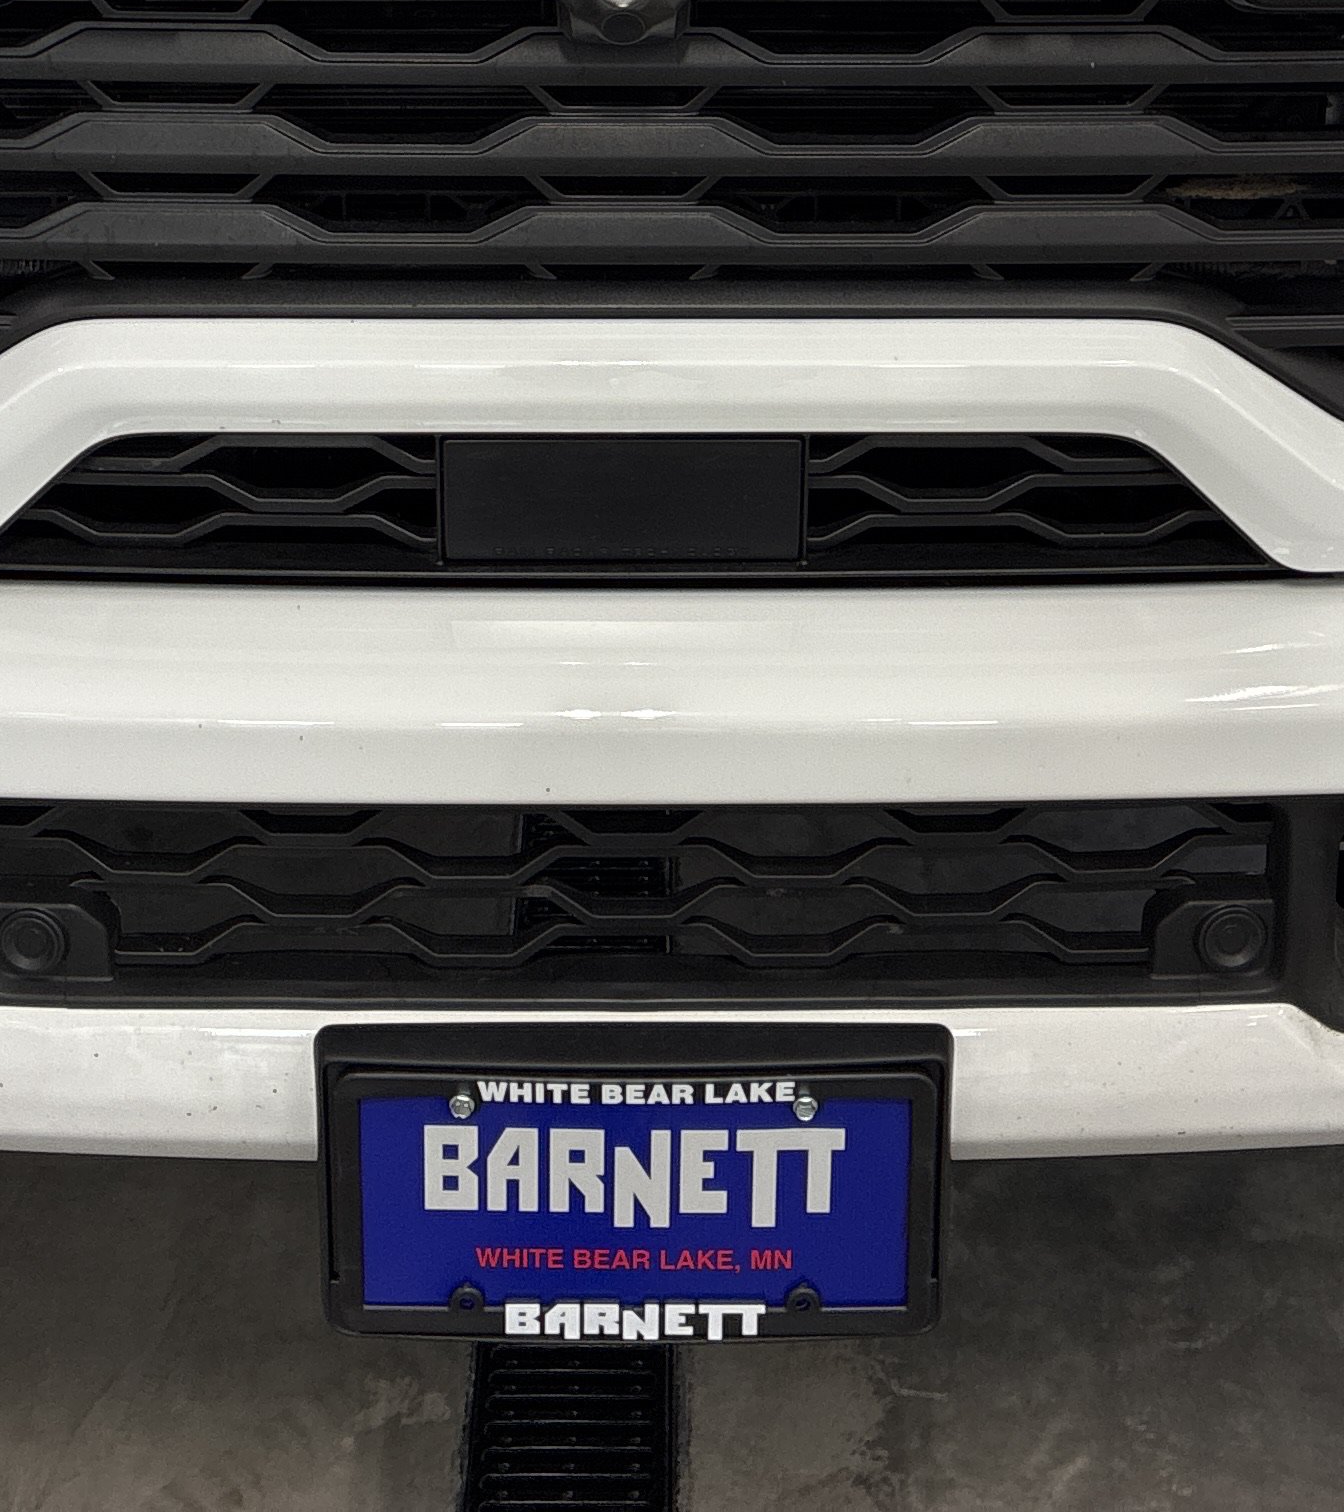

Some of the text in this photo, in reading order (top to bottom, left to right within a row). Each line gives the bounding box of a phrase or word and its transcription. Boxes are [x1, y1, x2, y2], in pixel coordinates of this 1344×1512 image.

[476, 1081, 796, 1105] WHITE BEAR LAKE
[423, 1124, 846, 1229] BARNETT
[475, 1248, 792, 1273] WHITE BEAR LAKE, MN
[504, 1303, 767, 1341] BARNETT
